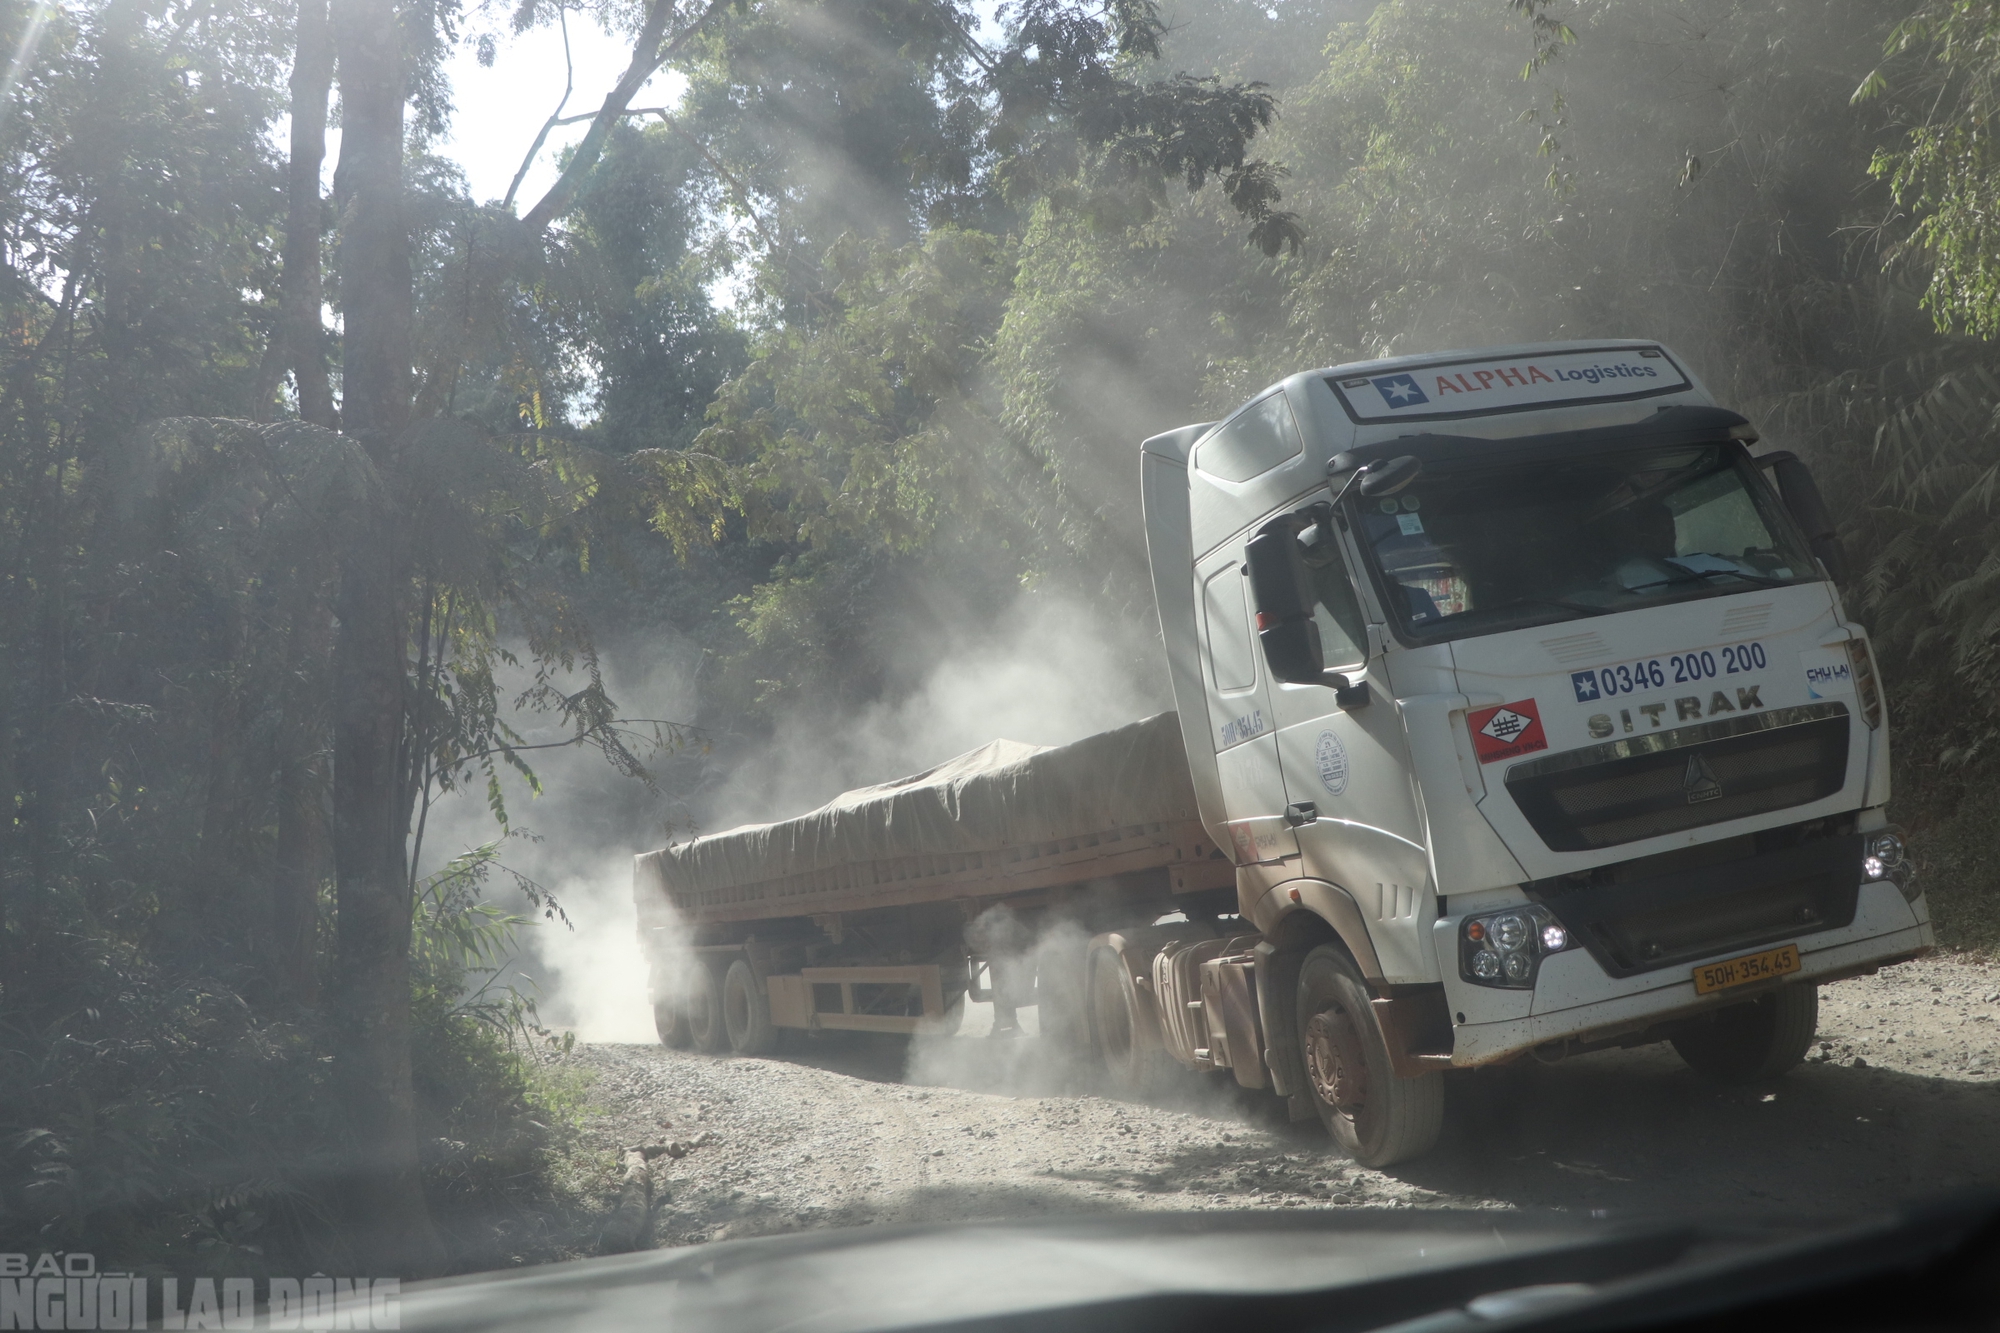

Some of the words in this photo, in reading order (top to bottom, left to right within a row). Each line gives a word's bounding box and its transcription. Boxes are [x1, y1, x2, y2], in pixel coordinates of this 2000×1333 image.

[1435, 365, 1554, 396] ALPHA
[1555, 363, 1657, 384] Logistics
[1601, 659, 1665, 696] 0346
[1670, 651, 1716, 684] 200
[1722, 642, 1766, 674] 200
[1806, 666, 1831, 679] CHU
[1832, 664, 1849, 675] LAI
[1587, 685, 1764, 739] SITRAK
